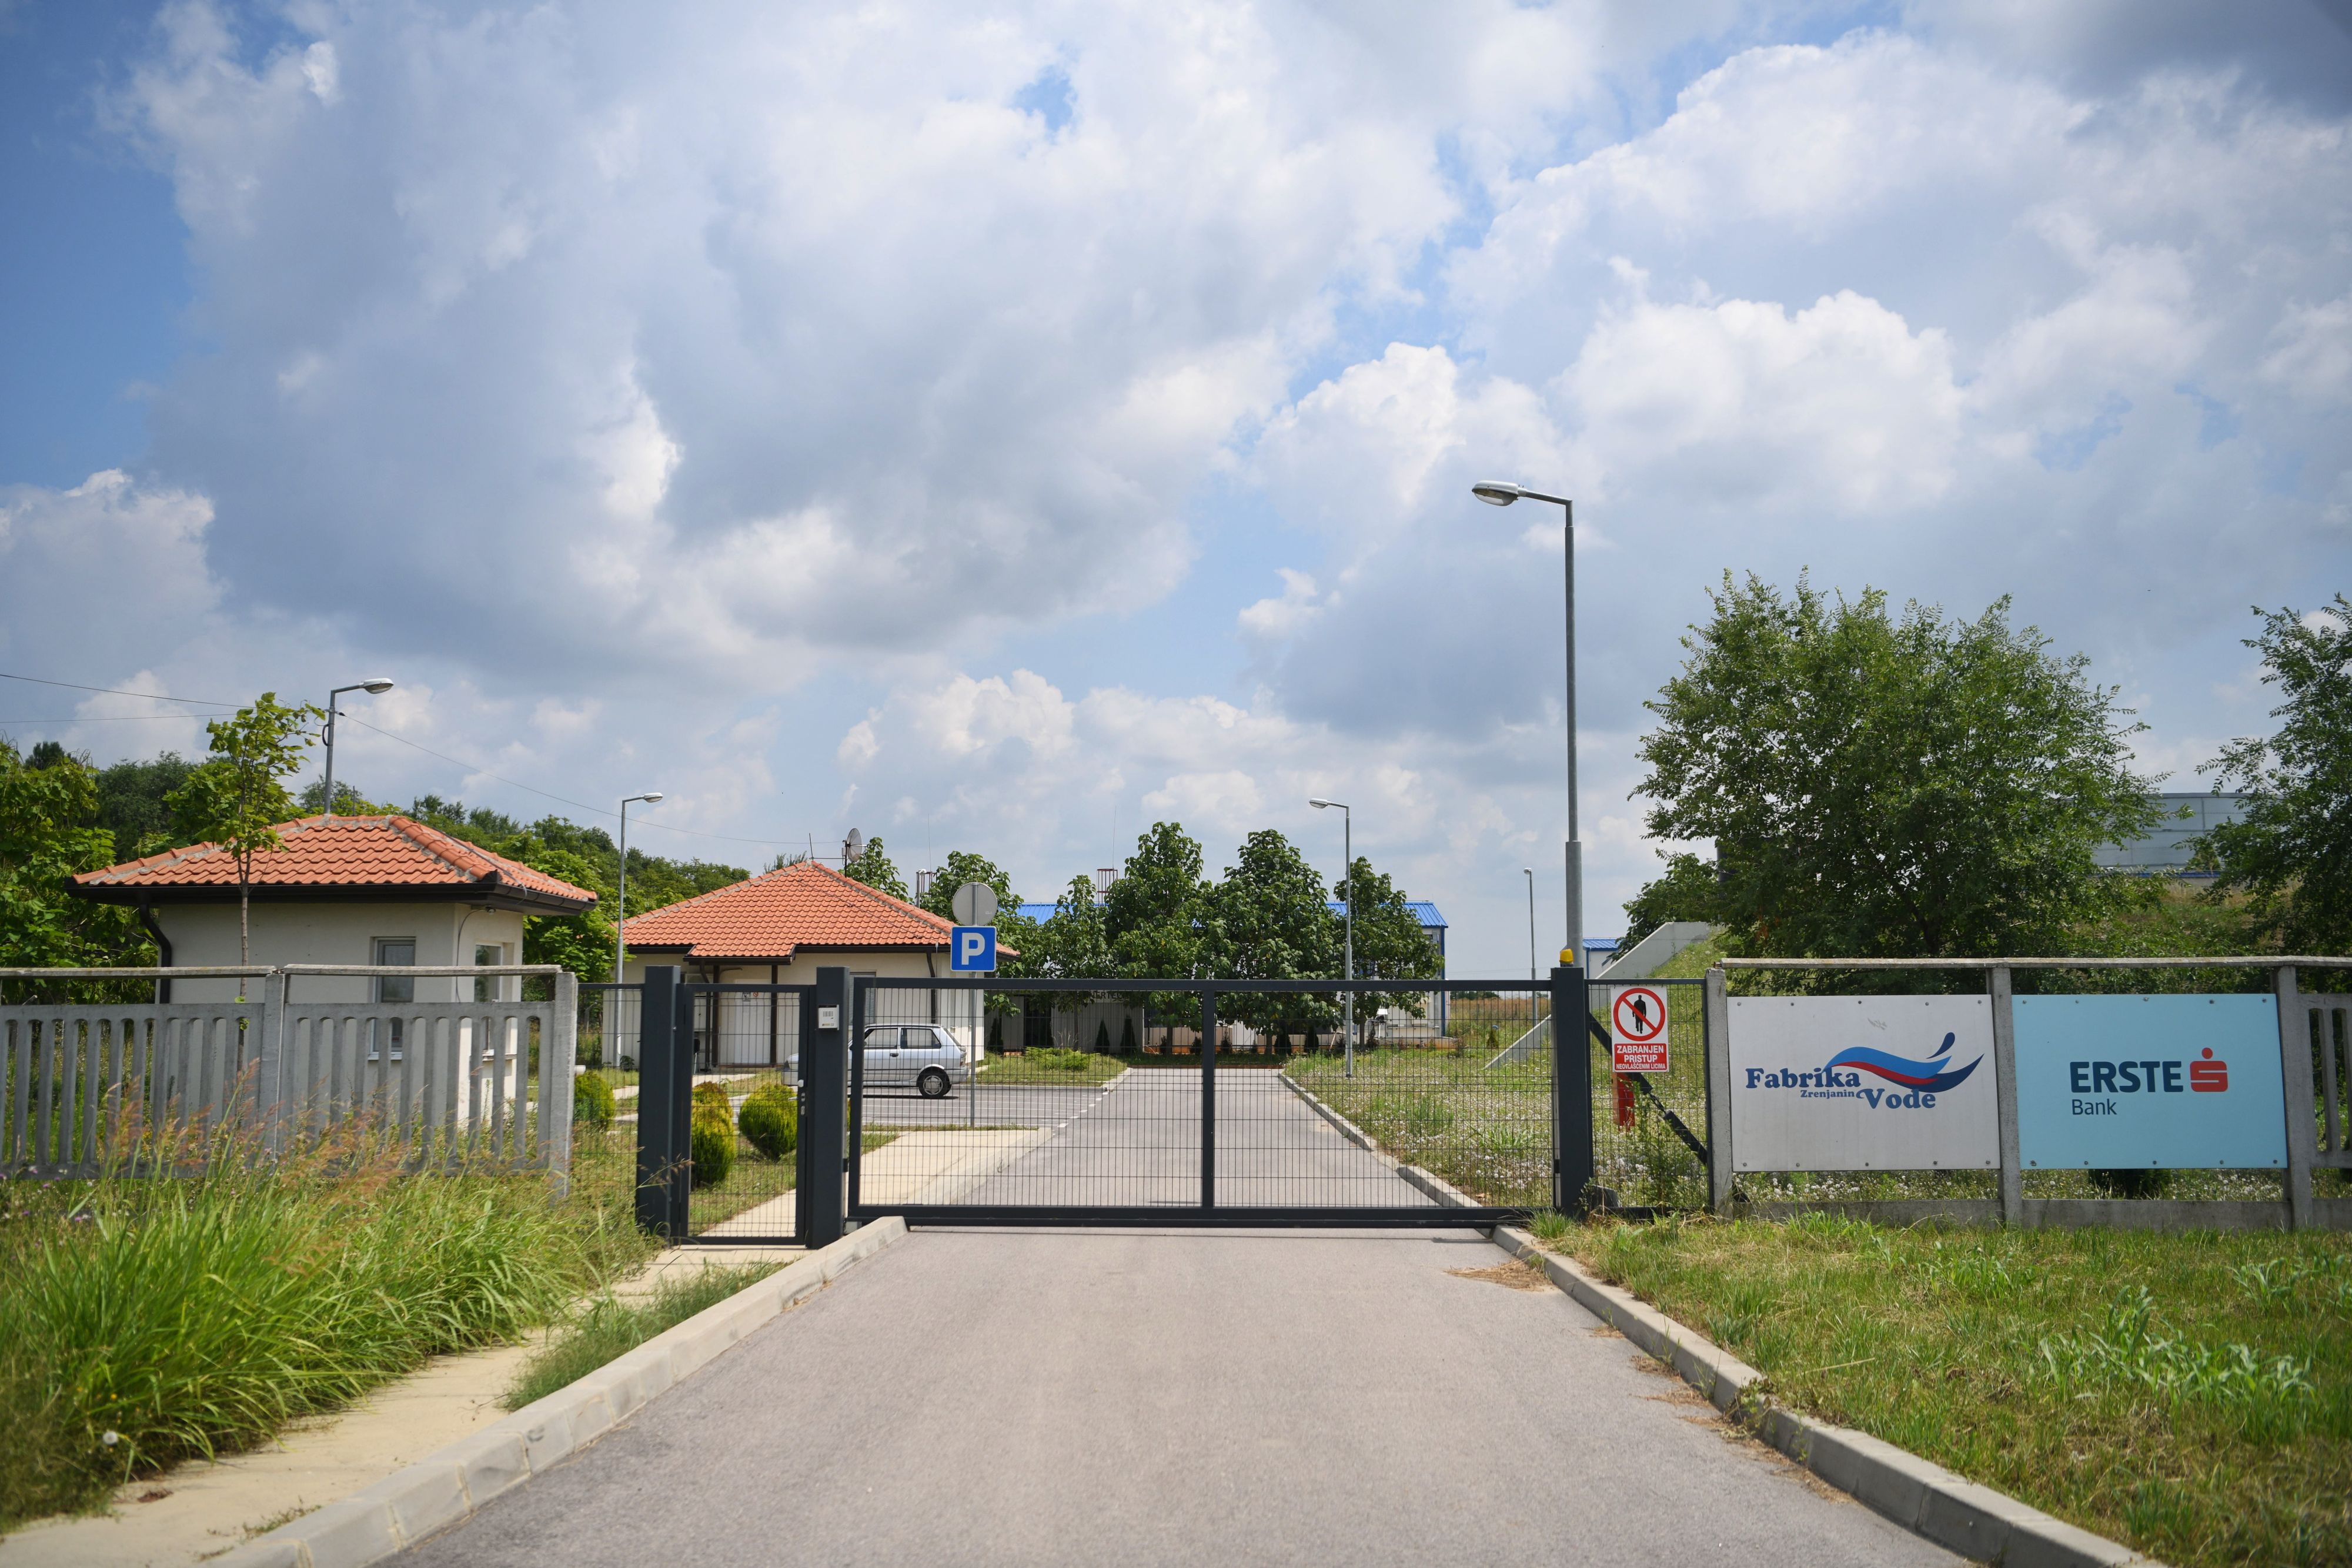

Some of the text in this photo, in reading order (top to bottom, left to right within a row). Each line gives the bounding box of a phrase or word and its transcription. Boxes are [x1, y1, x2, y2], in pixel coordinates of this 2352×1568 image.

[961, 932, 985, 965] P
[1616, 1045, 1664, 1054] ZABRANJEN
[1624, 1054, 1658, 1062] PRISTUP
[1745, 1067, 1861, 1089] Fabrika
[2070, 1061, 2184, 1093] ERSTE
[1800, 1089, 1855, 1099] Zrenjanin
[1856, 1088, 1936, 1109] Vode
[2072, 1098, 2117, 1115] Bank
